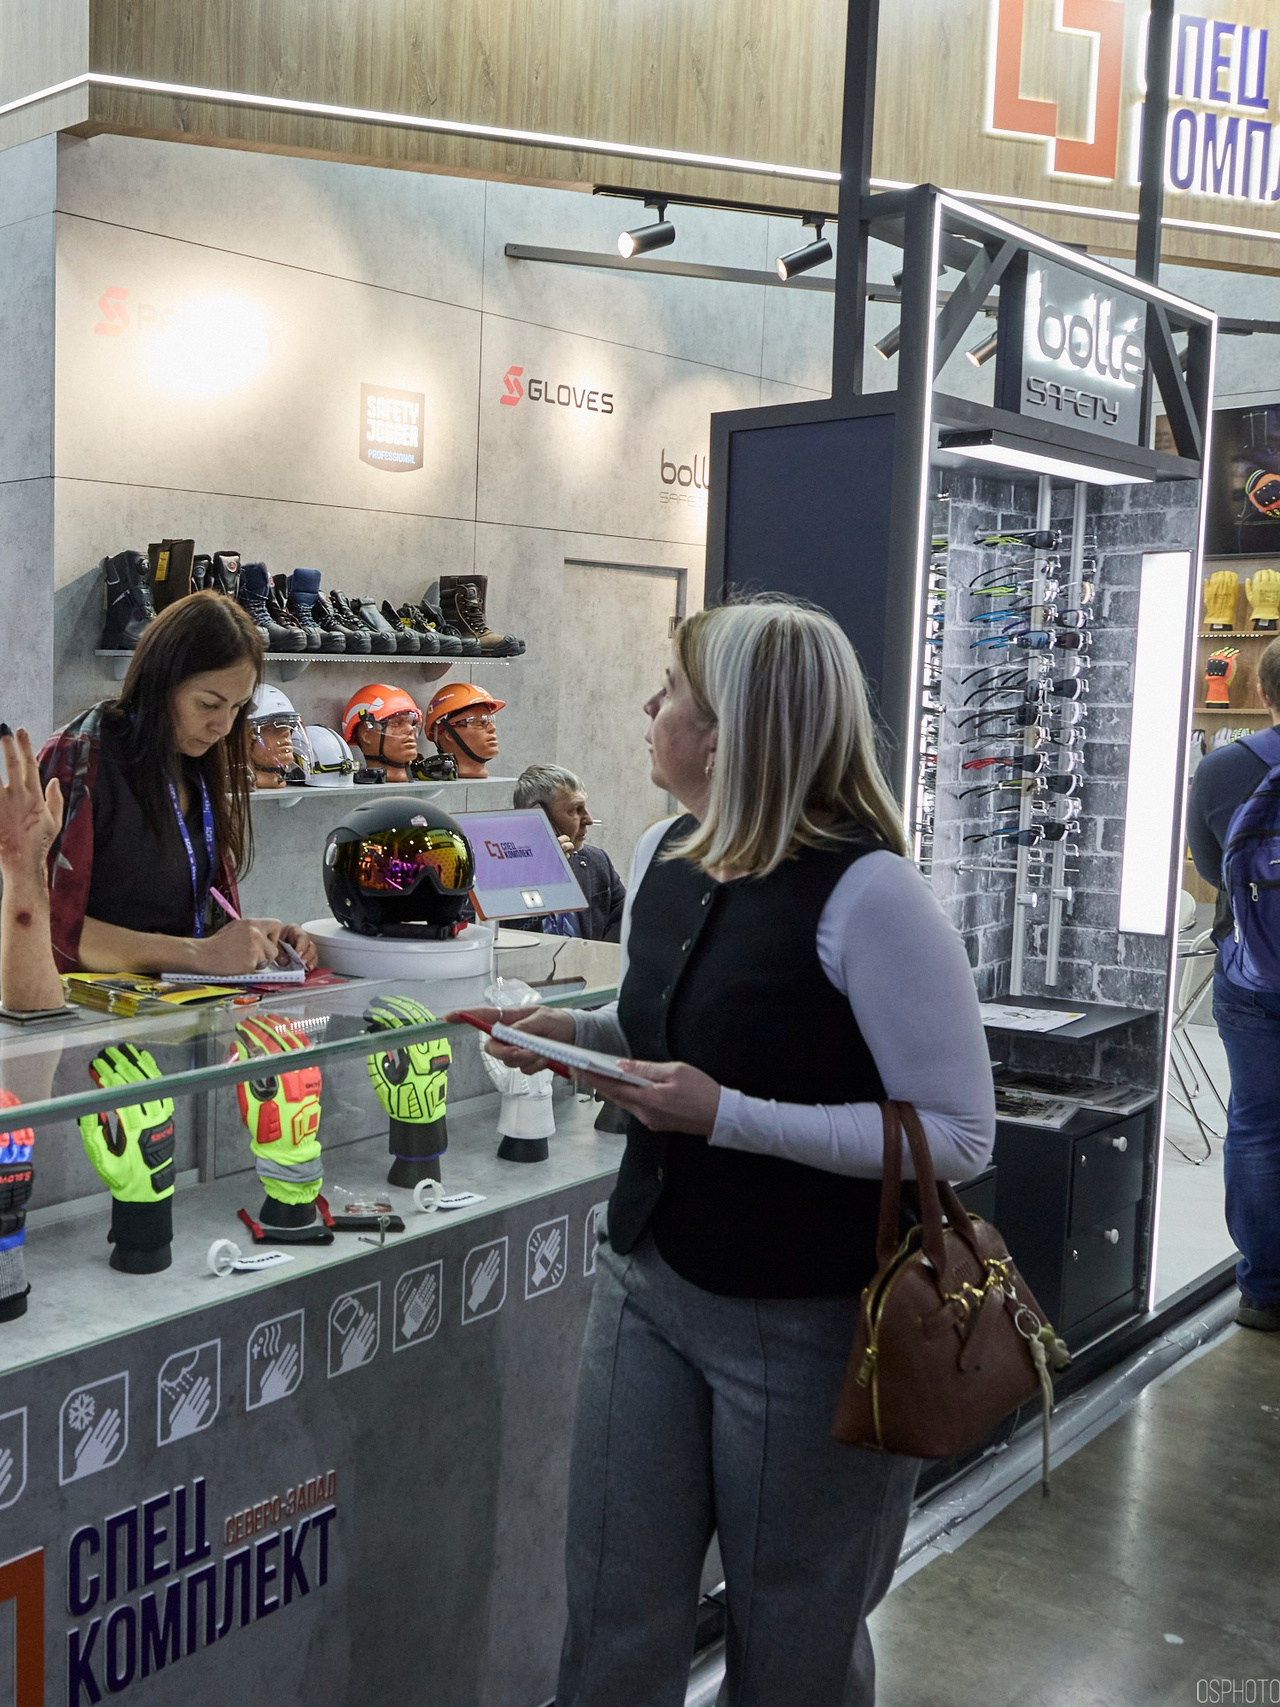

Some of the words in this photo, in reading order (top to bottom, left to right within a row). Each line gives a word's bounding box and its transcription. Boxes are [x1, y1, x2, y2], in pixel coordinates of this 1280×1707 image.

[1145, 11, 1269, 109] ПЕЦ
[1138, 103, 1280, 201] ОМП
[1037, 268, 1147, 388] bollé
[366, 395, 420, 425] SAFETY
[527, 378, 614, 414] GLOVES
[1027, 375, 1120, 426] SAFETY
[366, 418, 419, 448] JOGGER
[368, 448, 416, 464] PROFESSIONAL
[661, 448, 710, 490] boll
[500, 842, 518, 851] СПЕЦ
[504, 849, 534, 859] КОМПЛЕКТ
[224, 1469, 337, 1546] СЕВЕРО-ЗАПАД
[67, 1475, 211, 1617] СПЕЦ
[67, 1504, 337, 1707] КОМПЛЕКТ
